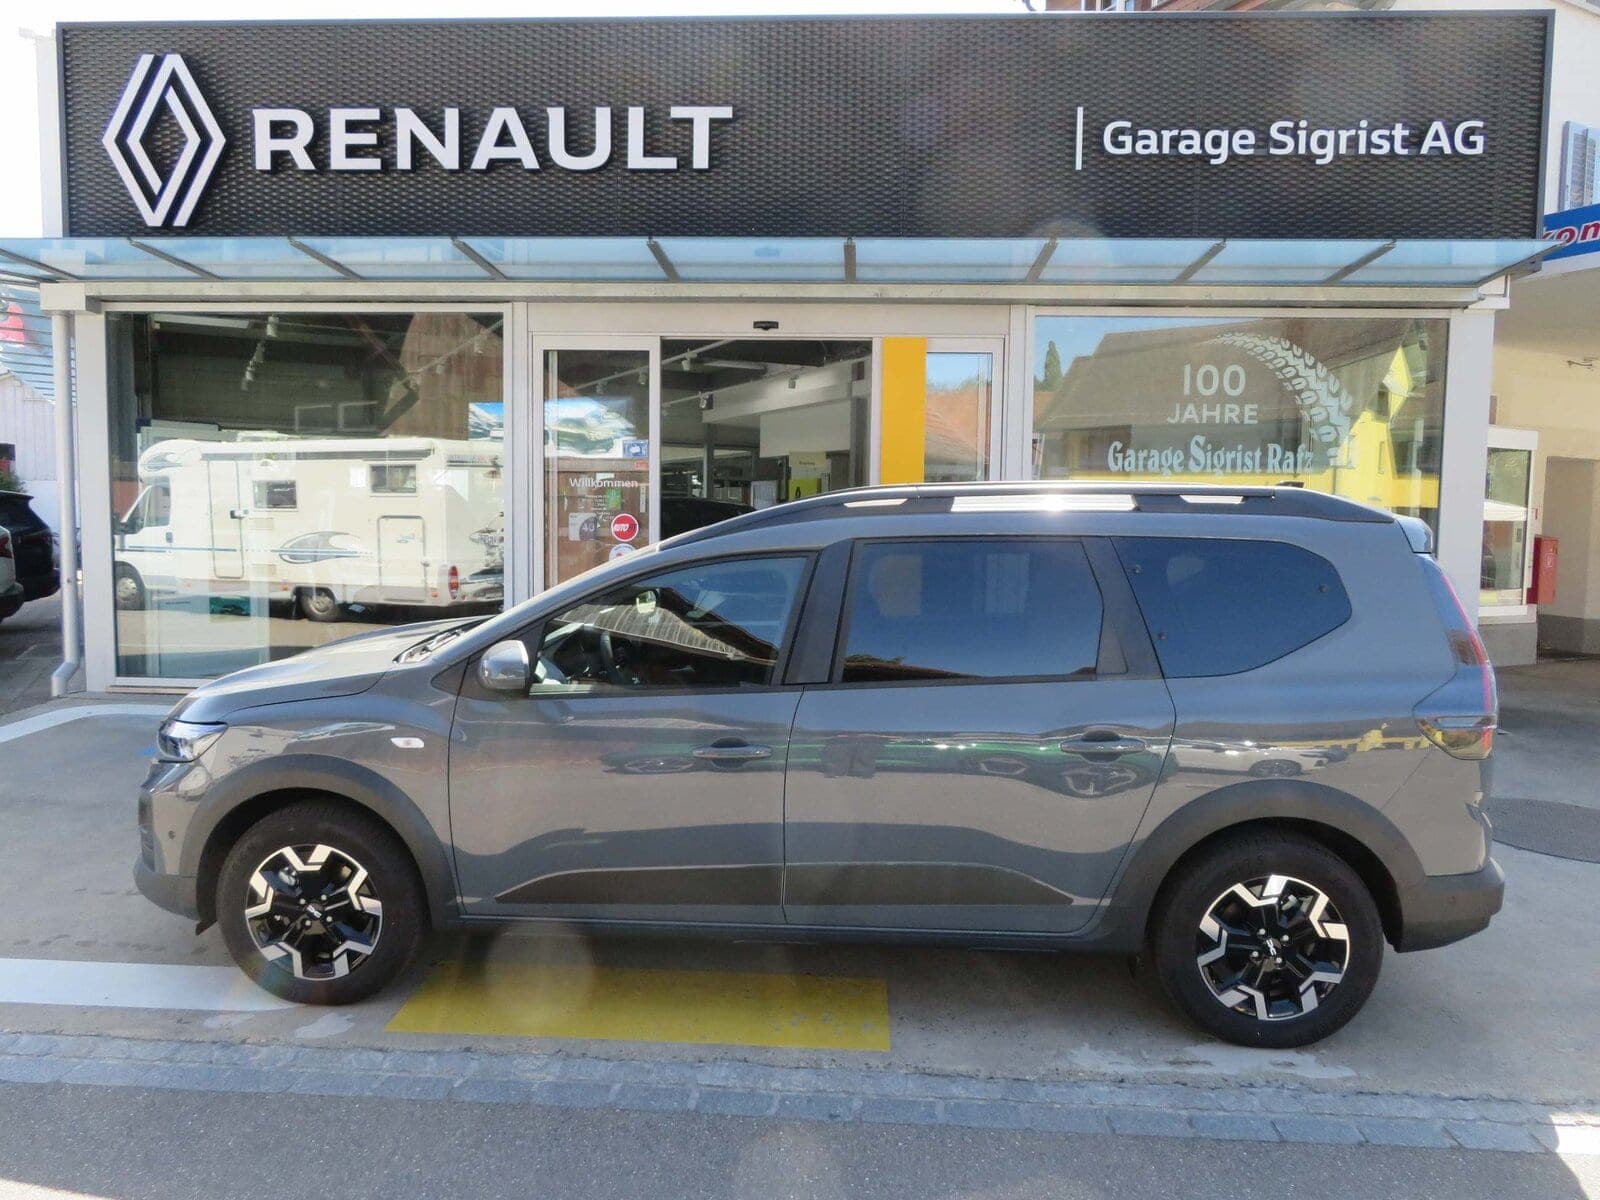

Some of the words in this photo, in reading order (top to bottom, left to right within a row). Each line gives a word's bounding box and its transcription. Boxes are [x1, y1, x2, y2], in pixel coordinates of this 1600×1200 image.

[252, 106, 734, 170] RENAULT
[1102, 120, 1255, 165] Garage
[1268, 118, 1410, 165] Sigrist
[1419, 119, 1485, 156] AG
[1182, 363, 1247, 397] 100
[1166, 402, 1259, 425] JAHRE
[1107, 440, 1184, 476] Garage
[1188, 434, 1262, 477] Sigrist
[1266, 443, 1314, 474] Rafz
[569, 477, 639, 489] Willkommen
